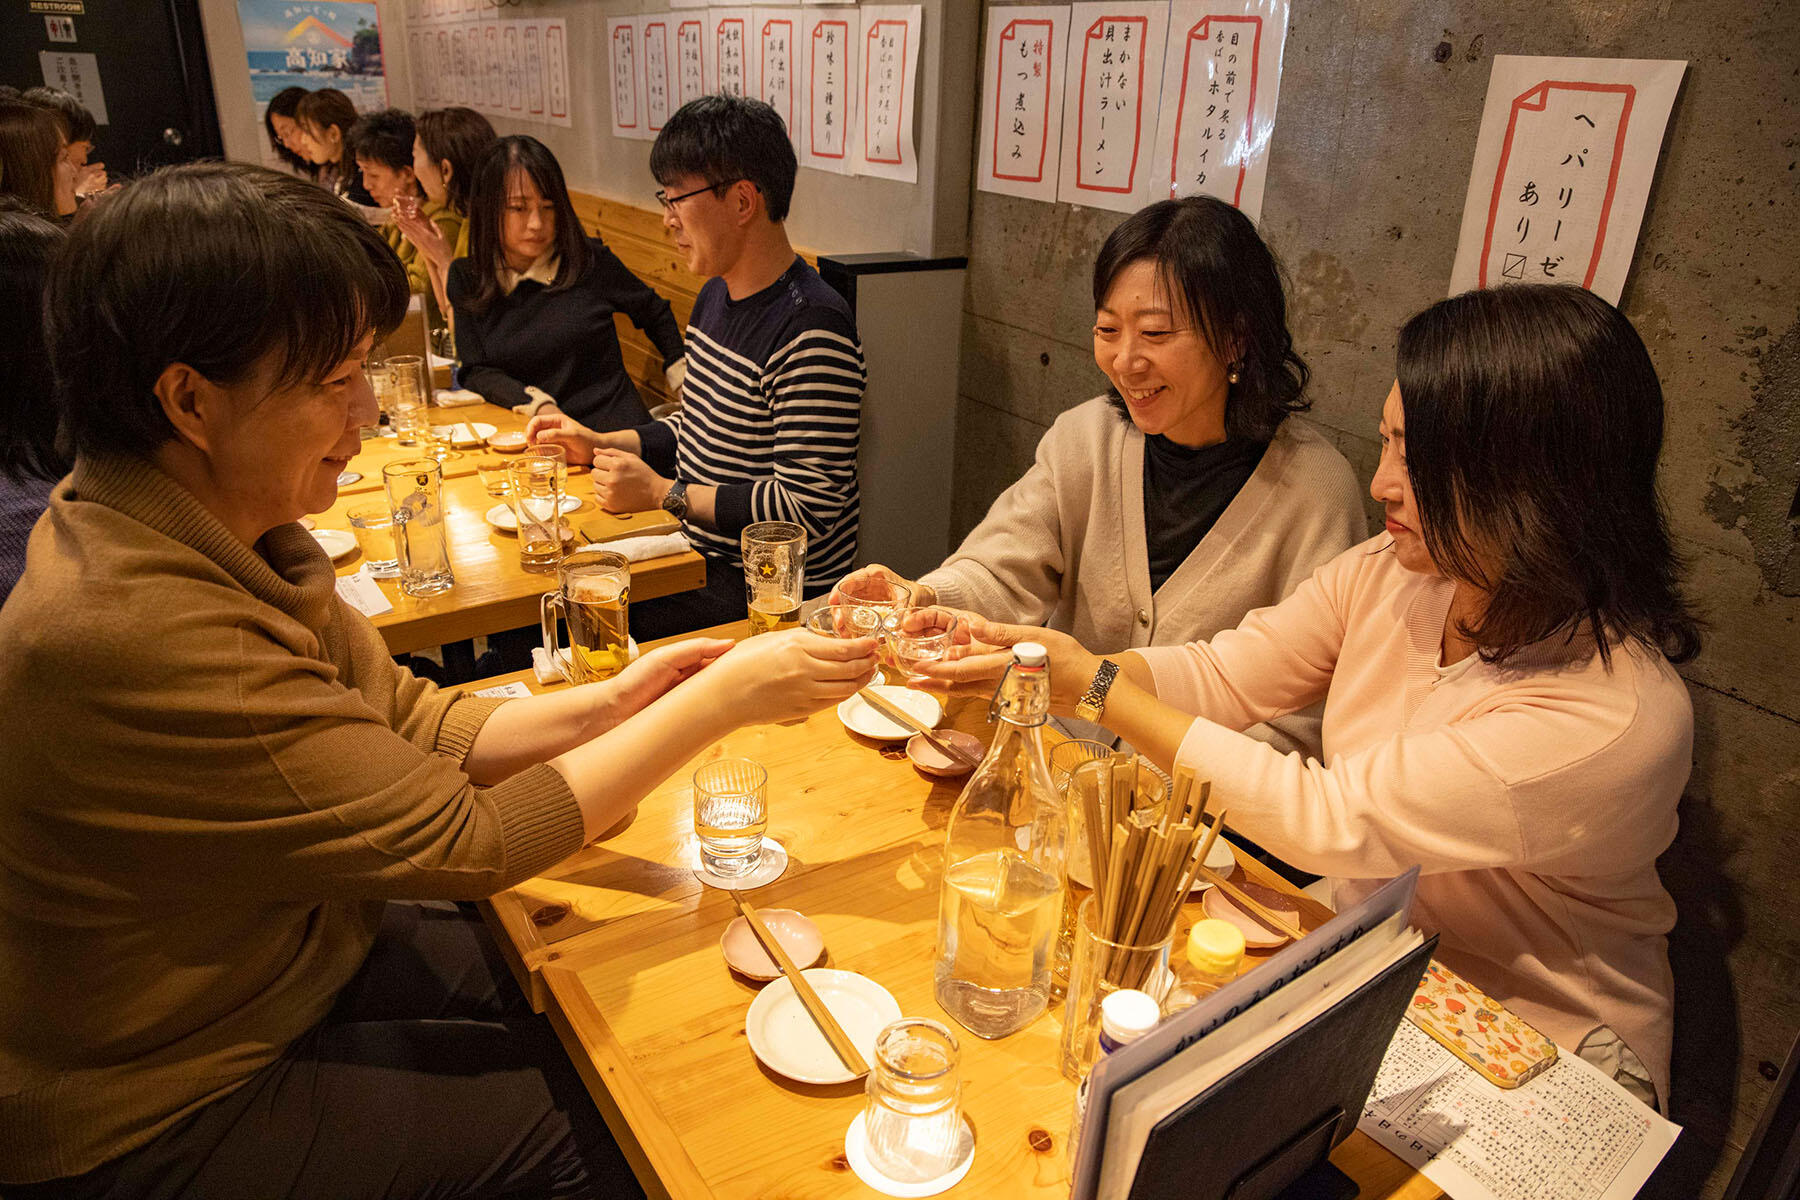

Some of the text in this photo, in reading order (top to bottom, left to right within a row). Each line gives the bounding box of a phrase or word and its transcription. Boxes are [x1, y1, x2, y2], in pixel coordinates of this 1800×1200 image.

[30, 2, 81, 11] RESTROOM
[285, 47, 350, 69] 高知家
[1032, 39, 1045, 78] 特製
[825, 29, 835, 145] 珍味三種盛り
[1010, 40, 1030, 159] もつ煮込み
[1095, 24, 1115, 175] 貝出汁ラーメン
[1115, 25, 1131, 110] まかない
[1196, 31, 1224, 184] 香ばしホタルイカ
[1217, 32, 1240, 141] 目の前で炙る
[1539, 113, 1596, 277] ヘパリーゼ
[1363, 1106, 1441, 1161] 本日の日本
